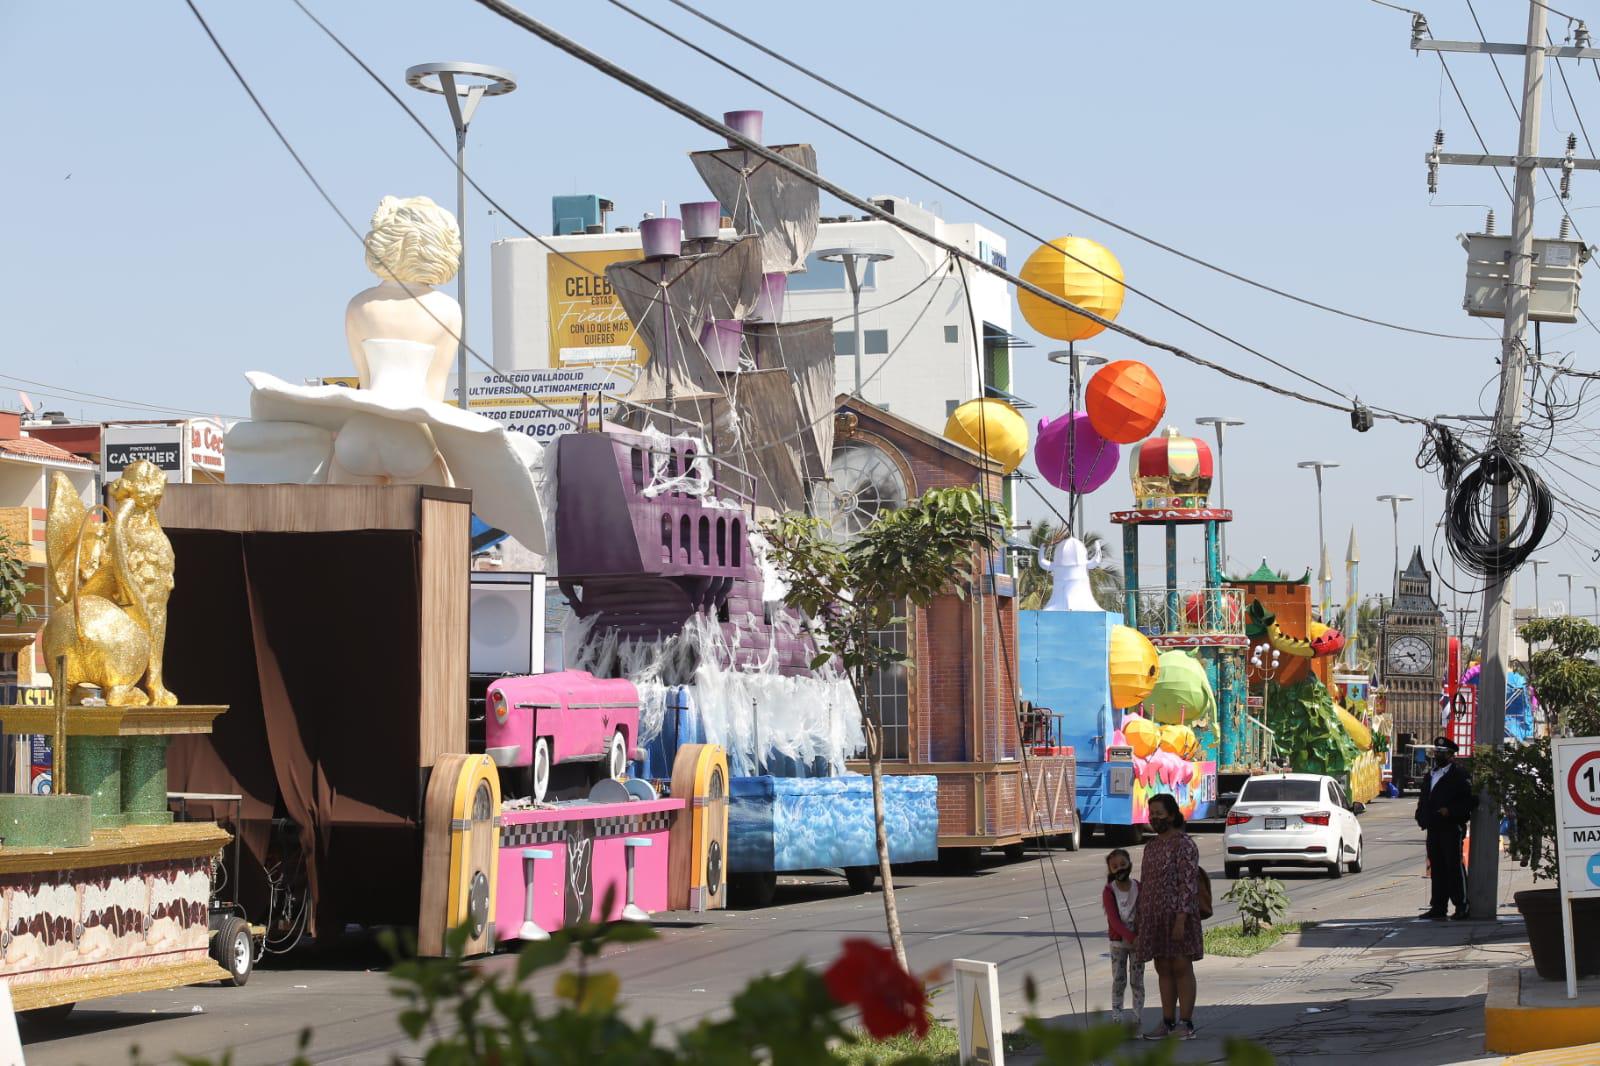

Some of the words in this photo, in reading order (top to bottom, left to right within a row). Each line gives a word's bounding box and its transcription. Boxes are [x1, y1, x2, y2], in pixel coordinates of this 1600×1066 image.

[591, 295, 613, 305] ESTAS
[558, 299, 630, 331] Fiesta
[570, 324, 585, 334] CON
[586, 323, 596, 333] LO
[597, 323, 611, 333] QUE
[584, 334, 615, 345] QUIERES
[492, 374, 530, 383] COLEGIO
[532, 372, 584, 382] VALLADOLID
[468, 385, 532, 395] ULTIVERSIDAD
[533, 382, 615, 394] LATINOAMERICANA
[509, 409, 564, 419] EDUCATIVO
[109, 451, 176, 464] CASTHER
[1583, 766, 1600, 793] 1
